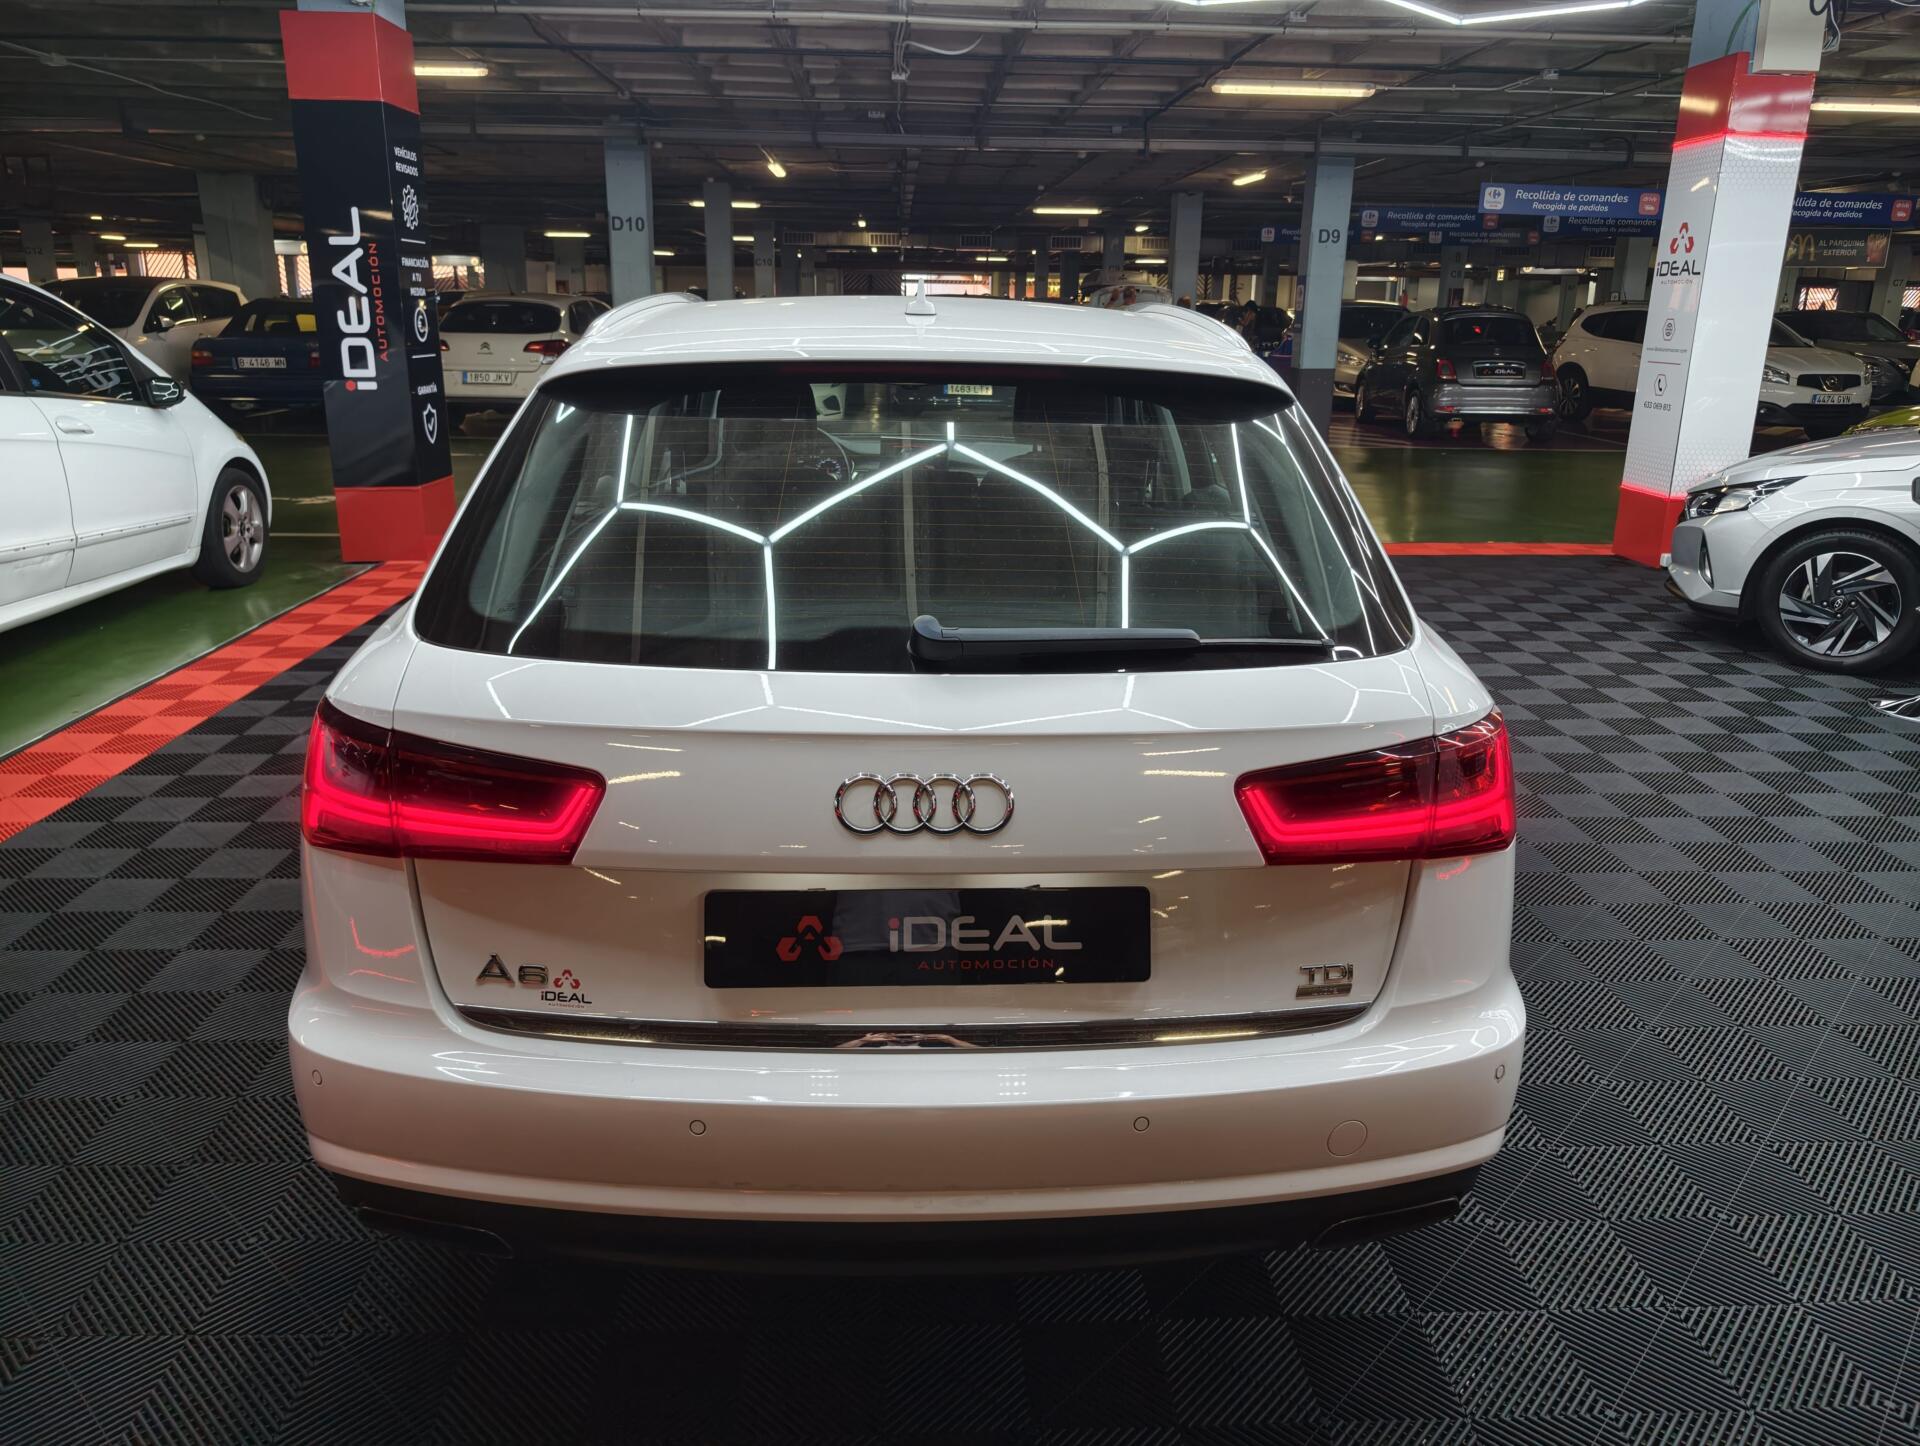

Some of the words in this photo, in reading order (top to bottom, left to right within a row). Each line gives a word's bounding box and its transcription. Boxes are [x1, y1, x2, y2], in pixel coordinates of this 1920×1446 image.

[1515, 189, 1561, 201] Recollida
[1563, 191, 1576, 201] de
[1578, 193, 1629, 203] comandes
[1532, 202, 1566, 211] Recogida
[1567, 203, 1577, 211] de
[1578, 204, 1609, 212] pedidos
[1819, 198, 1832, 207] de
[1834, 200, 1883, 209] comandes
[1387, 211, 1423, 220] Recollida
[1425, 212, 1436, 220] de
[1437, 213, 1476, 221] comandes
[1822, 209, 1832, 217] de
[1833, 210, 1863, 218] pedidos
[611, 216, 645, 232] D10
[1568, 216, 1604, 225] Recollida
[1606, 217, 1616, 225] de
[1318, 228, 1341, 243] D9
[1823, 248, 1857, 256] EXTERIOR
[1656, 259, 1701, 277] iDEAL
[368, 242, 389, 362] AUTOMOCIÓN
[950, 385, 971, 393] 1463
[1816, 395, 1835, 403] 4474
[888, 915, 1083, 952] iDEAL
[918, 958, 1055, 970] AUTOMOCIÓN
[475, 953, 549, 988] A6
[1299, 963, 1353, 985] TDI
[540, 991, 593, 1004] iDEAL
